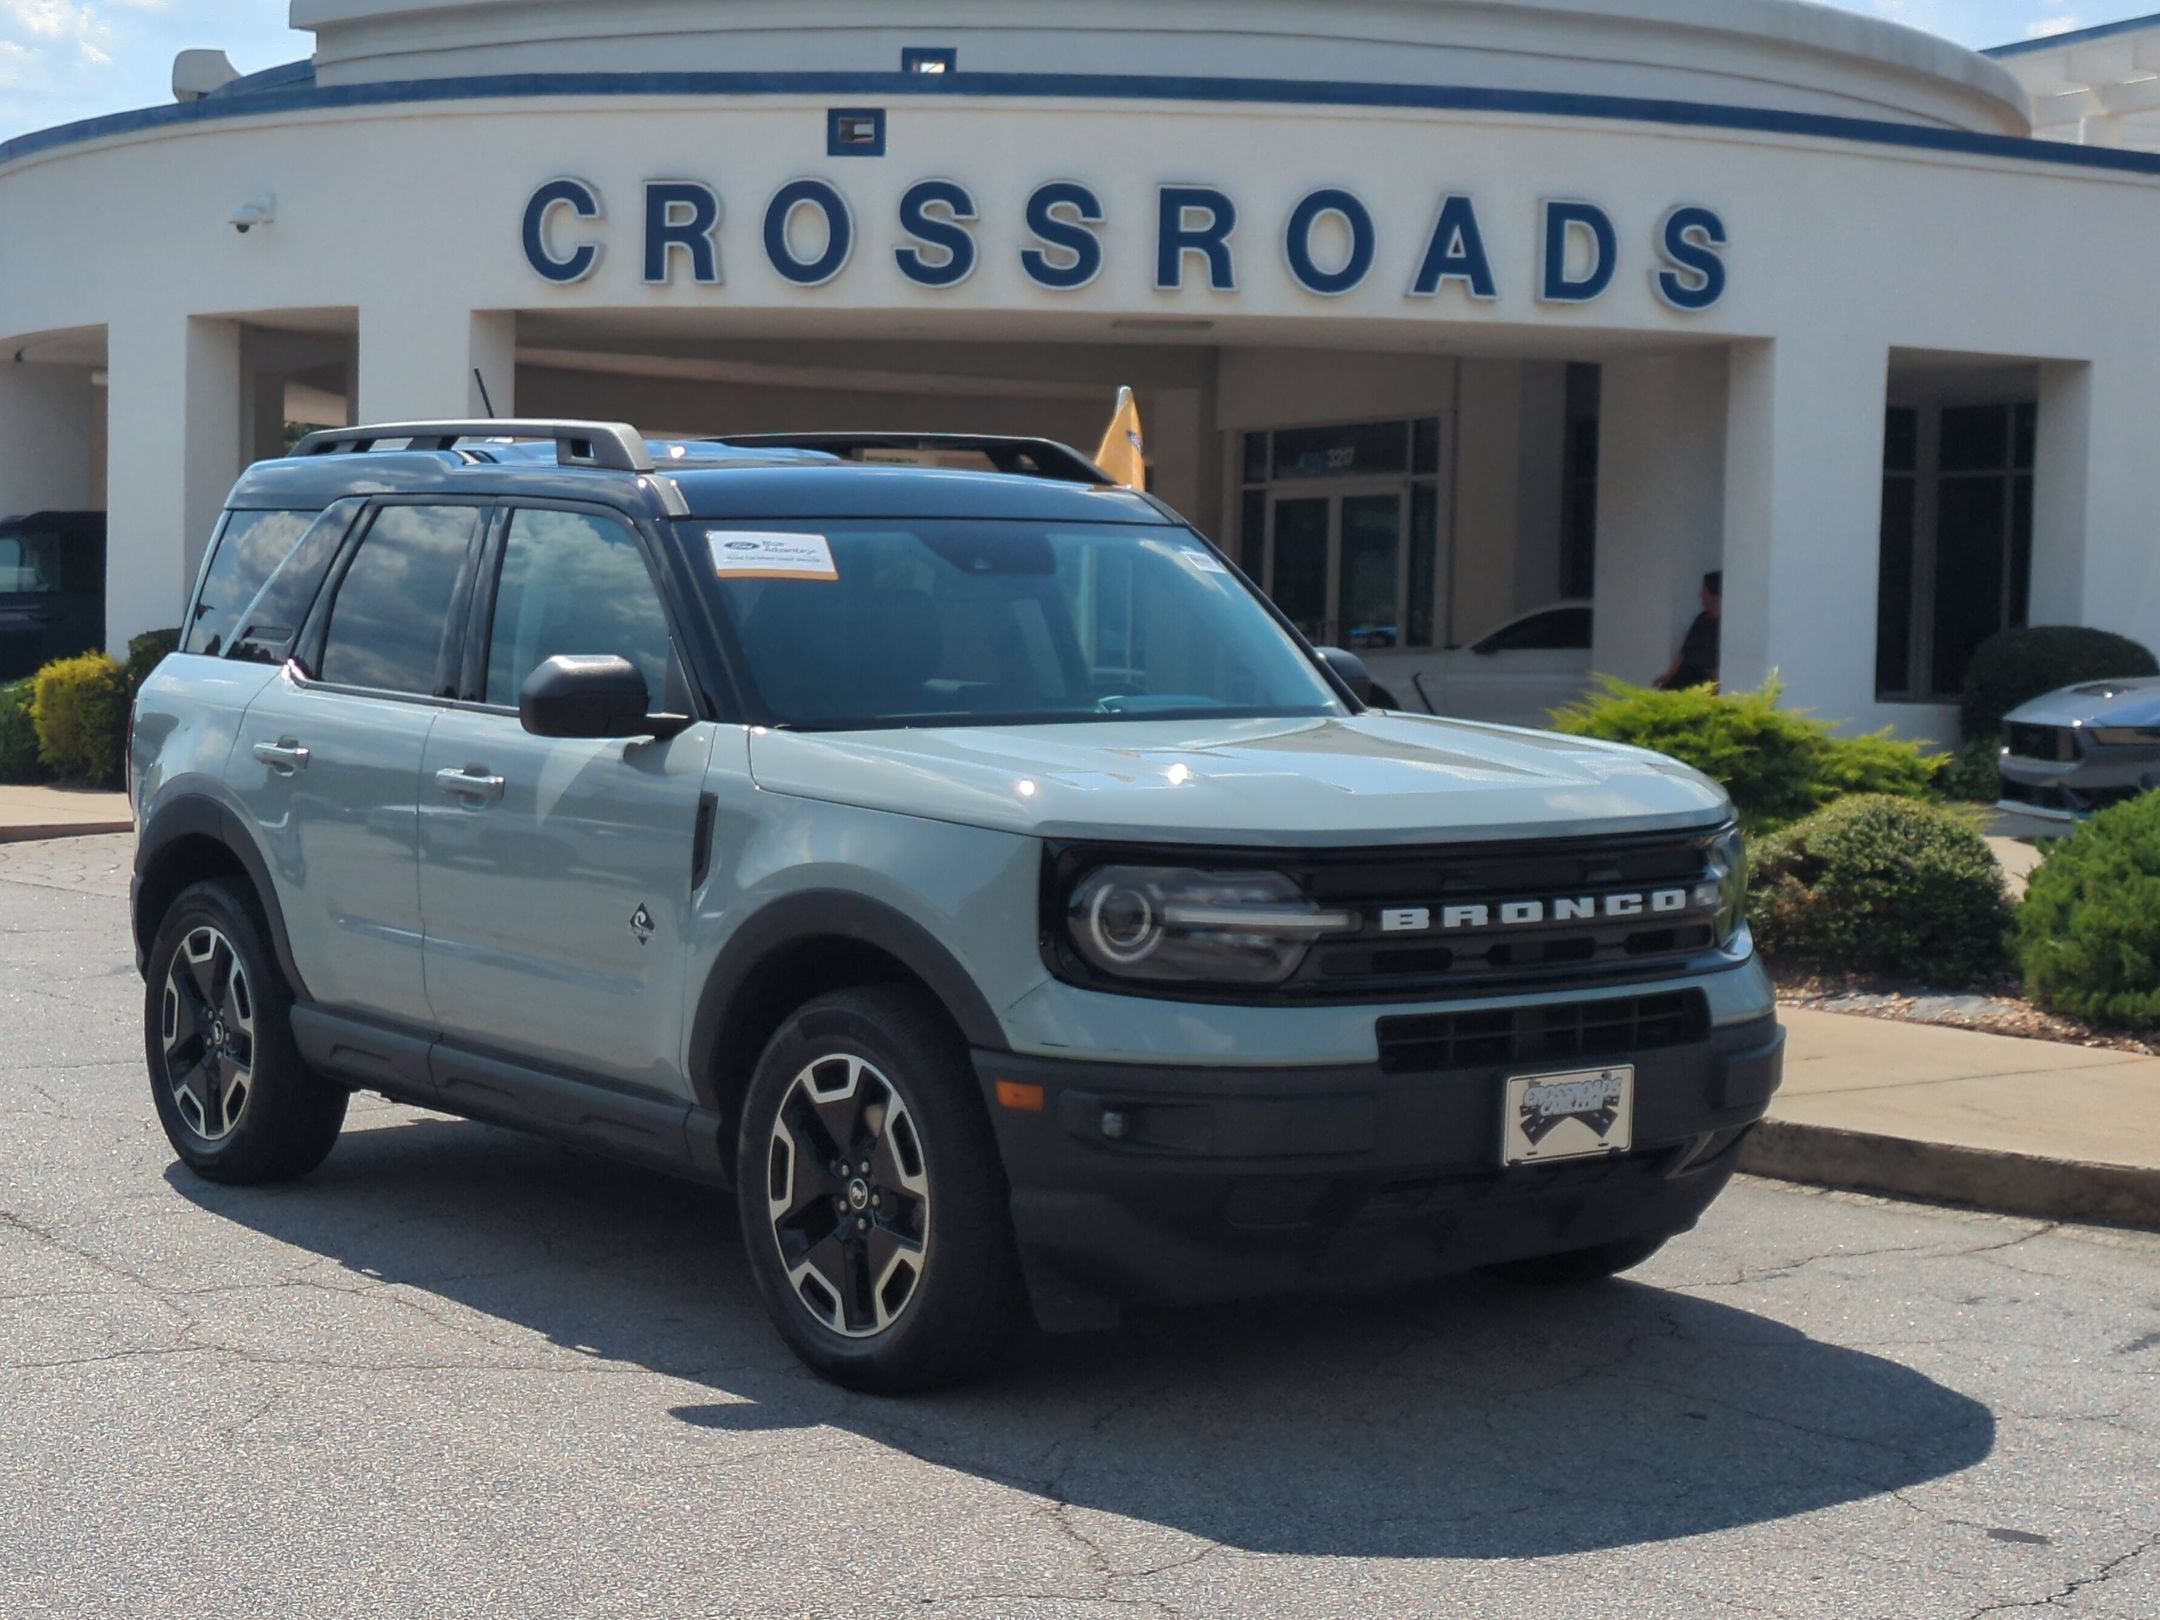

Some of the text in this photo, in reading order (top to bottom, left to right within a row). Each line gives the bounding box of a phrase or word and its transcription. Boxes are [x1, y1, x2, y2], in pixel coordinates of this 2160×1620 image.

[521, 177, 1727, 312] CROSSROADS
[1381, 889, 1687, 931] BRONCO
[1523, 1077, 1622, 1108] CROSSROADS
